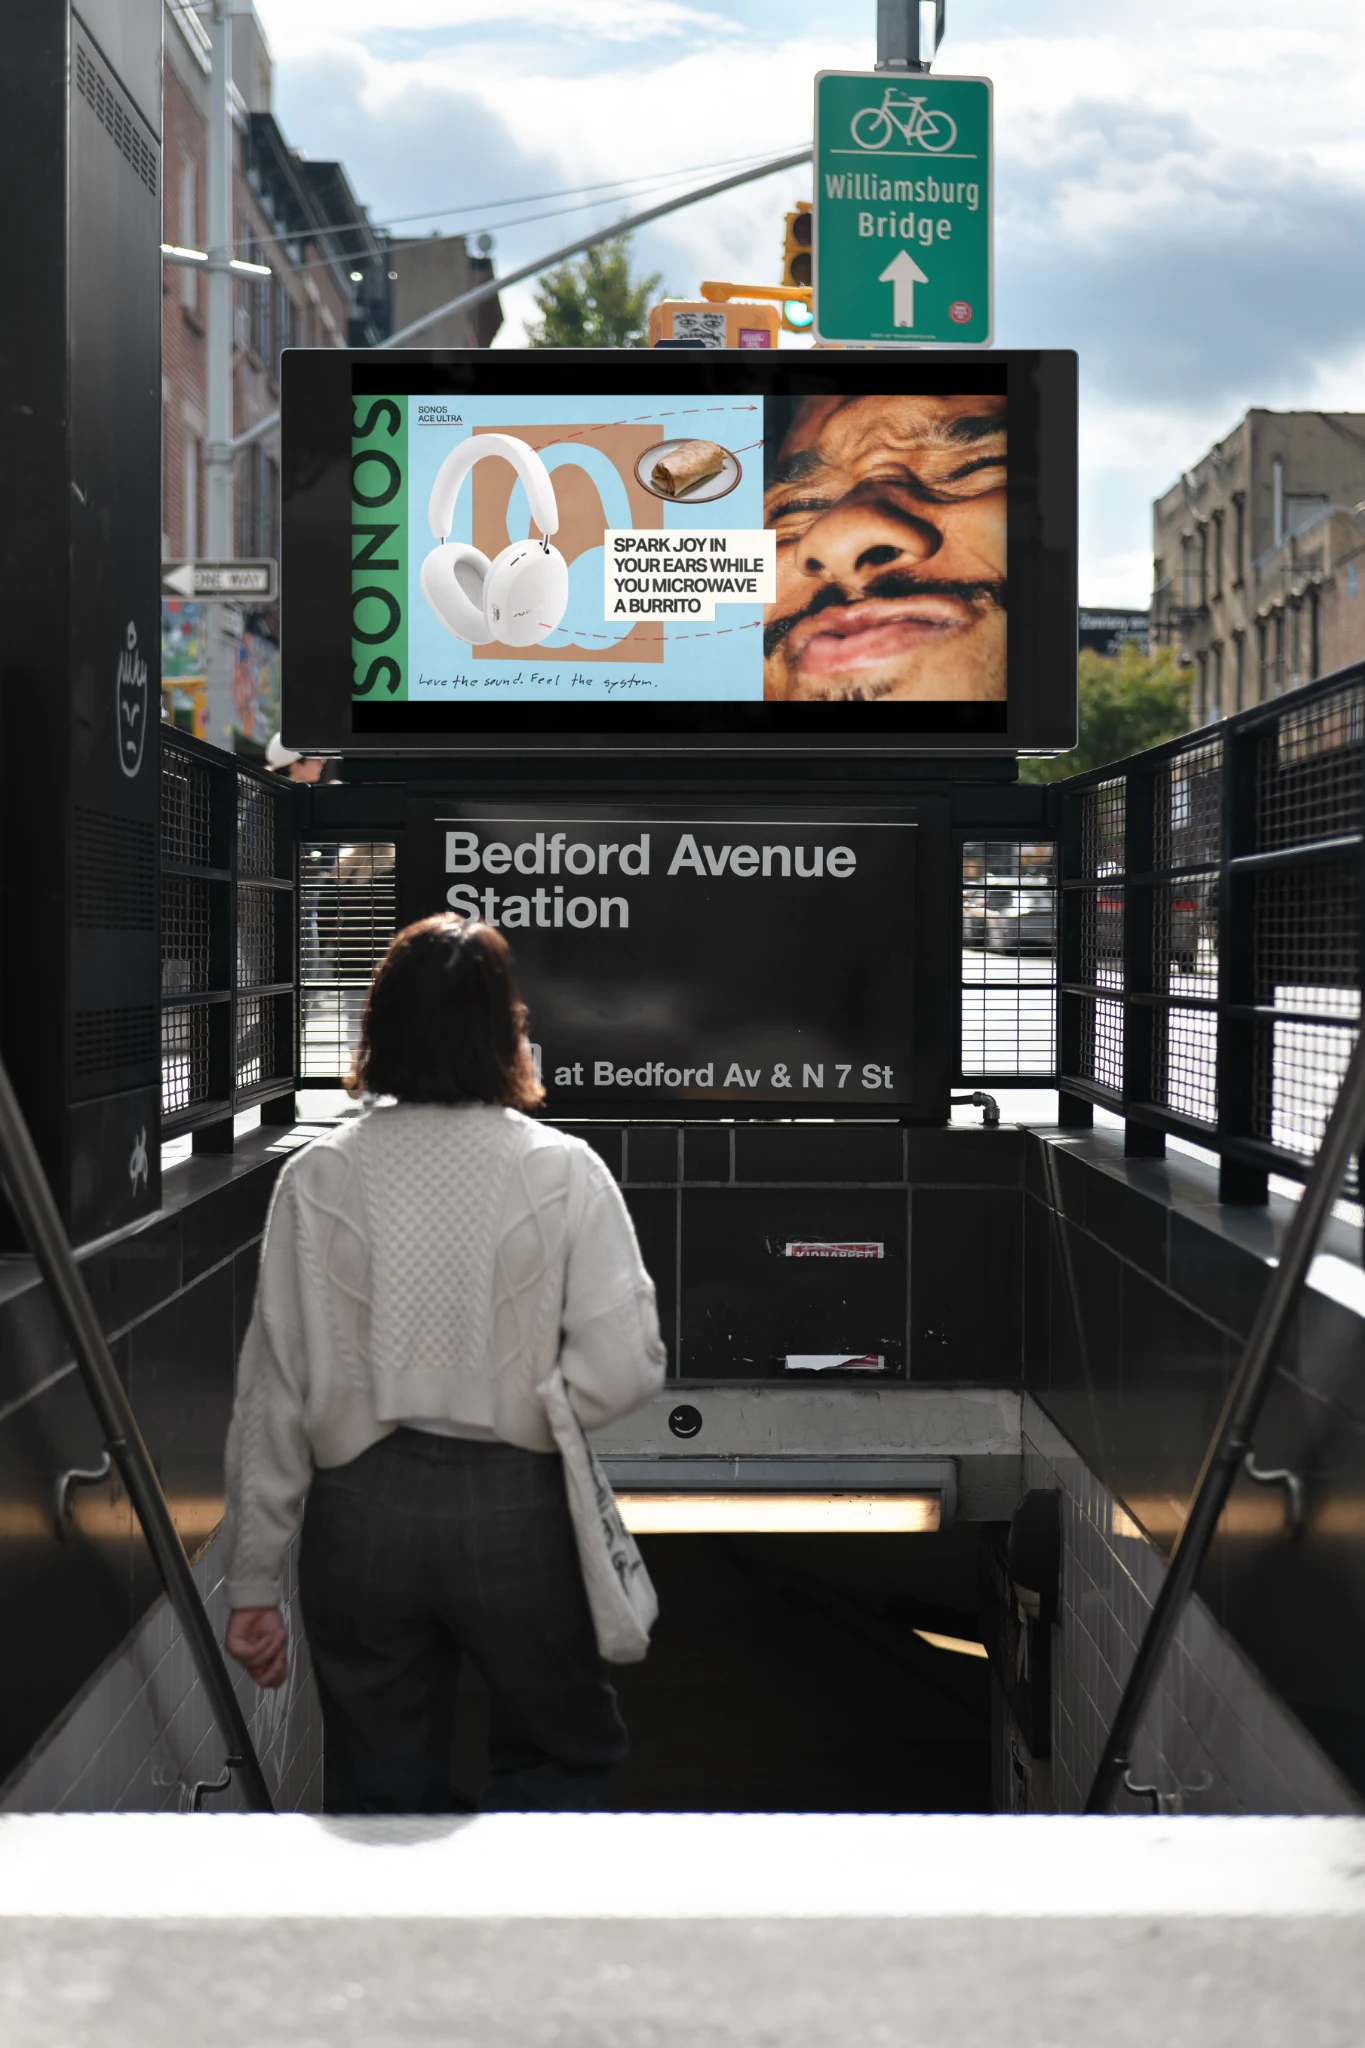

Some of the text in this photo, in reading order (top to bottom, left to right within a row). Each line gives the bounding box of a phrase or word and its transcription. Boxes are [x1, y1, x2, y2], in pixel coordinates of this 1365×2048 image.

[824, 171, 980, 212] Williamsburg
[857, 210, 953, 247] Bridge
[418, 405, 448, 414] SONOS
[418, 414, 463, 422] ACE ULTRA
[351, 398, 402, 696] SONOS
[613, 537, 727, 553] SPARK JOY IN
[613, 557, 764, 573] YOUR EARS WHILE
[231, 571, 263, 587] WAY
[613, 577, 758, 593] YOU MICROWAVE
[613, 597, 702, 614] A BURRITO
[418, 672, 659, 694] Love the sound. Feel the system.
[444, 830, 858, 878] Bedford Avenue
[445, 883, 630, 929] Station
[554, 1061, 894, 1090] at Bedford Av & N 7 St
